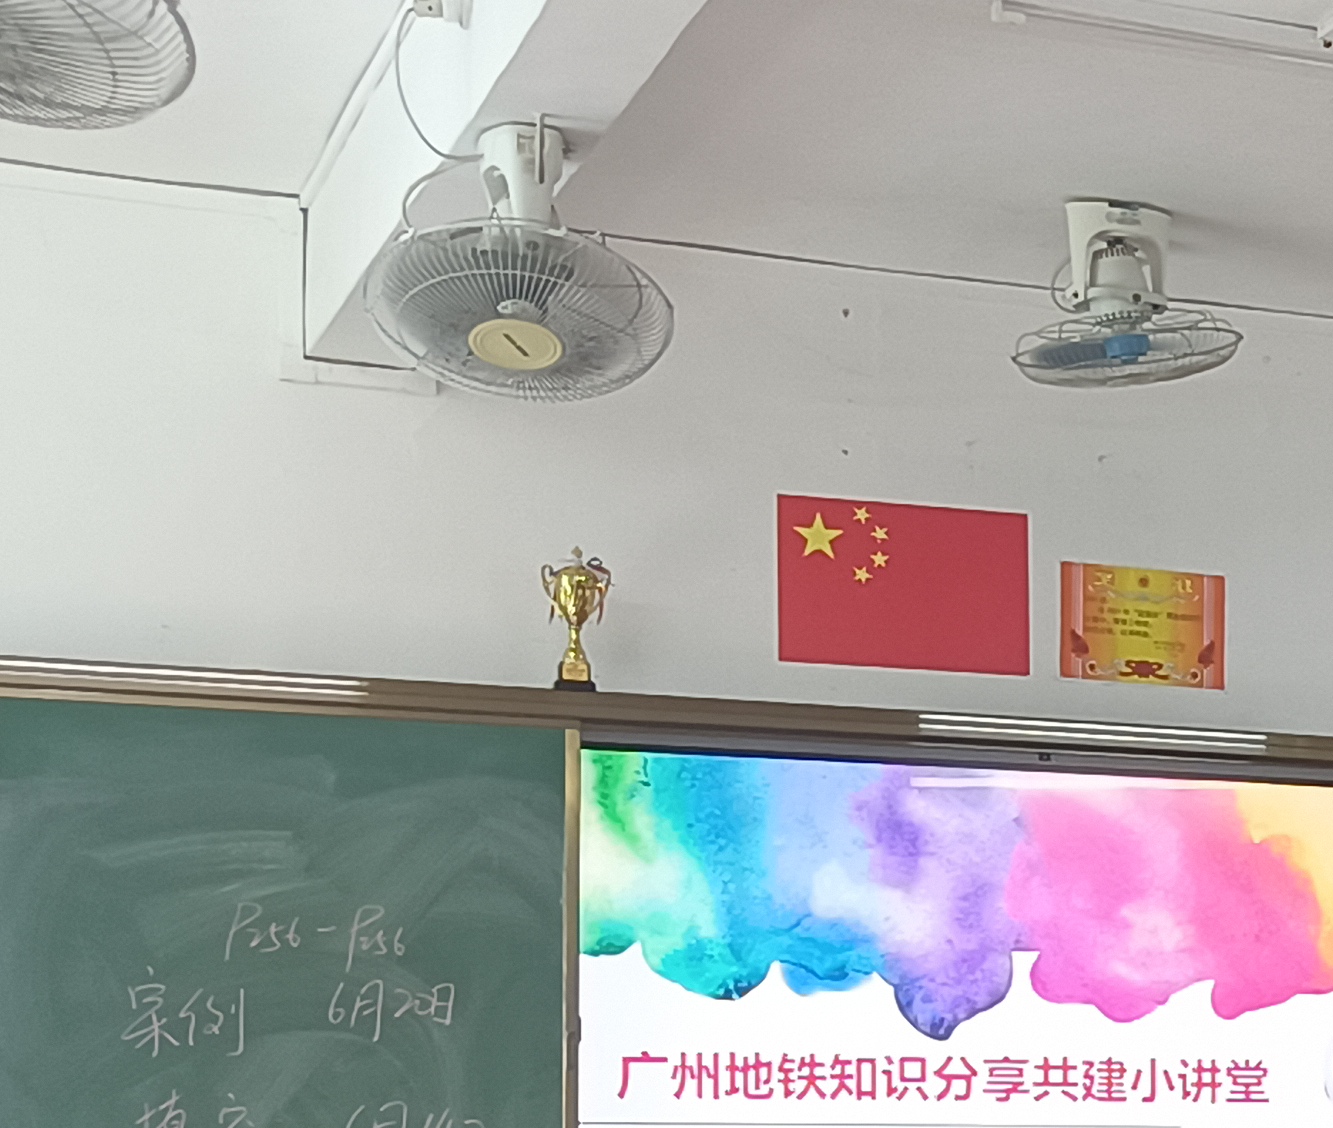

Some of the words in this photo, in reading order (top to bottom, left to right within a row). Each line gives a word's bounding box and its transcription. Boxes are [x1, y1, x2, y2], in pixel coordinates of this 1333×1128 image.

[617, 1051, 1270, 1102] 广州地铁知识分享共建小讲堂
